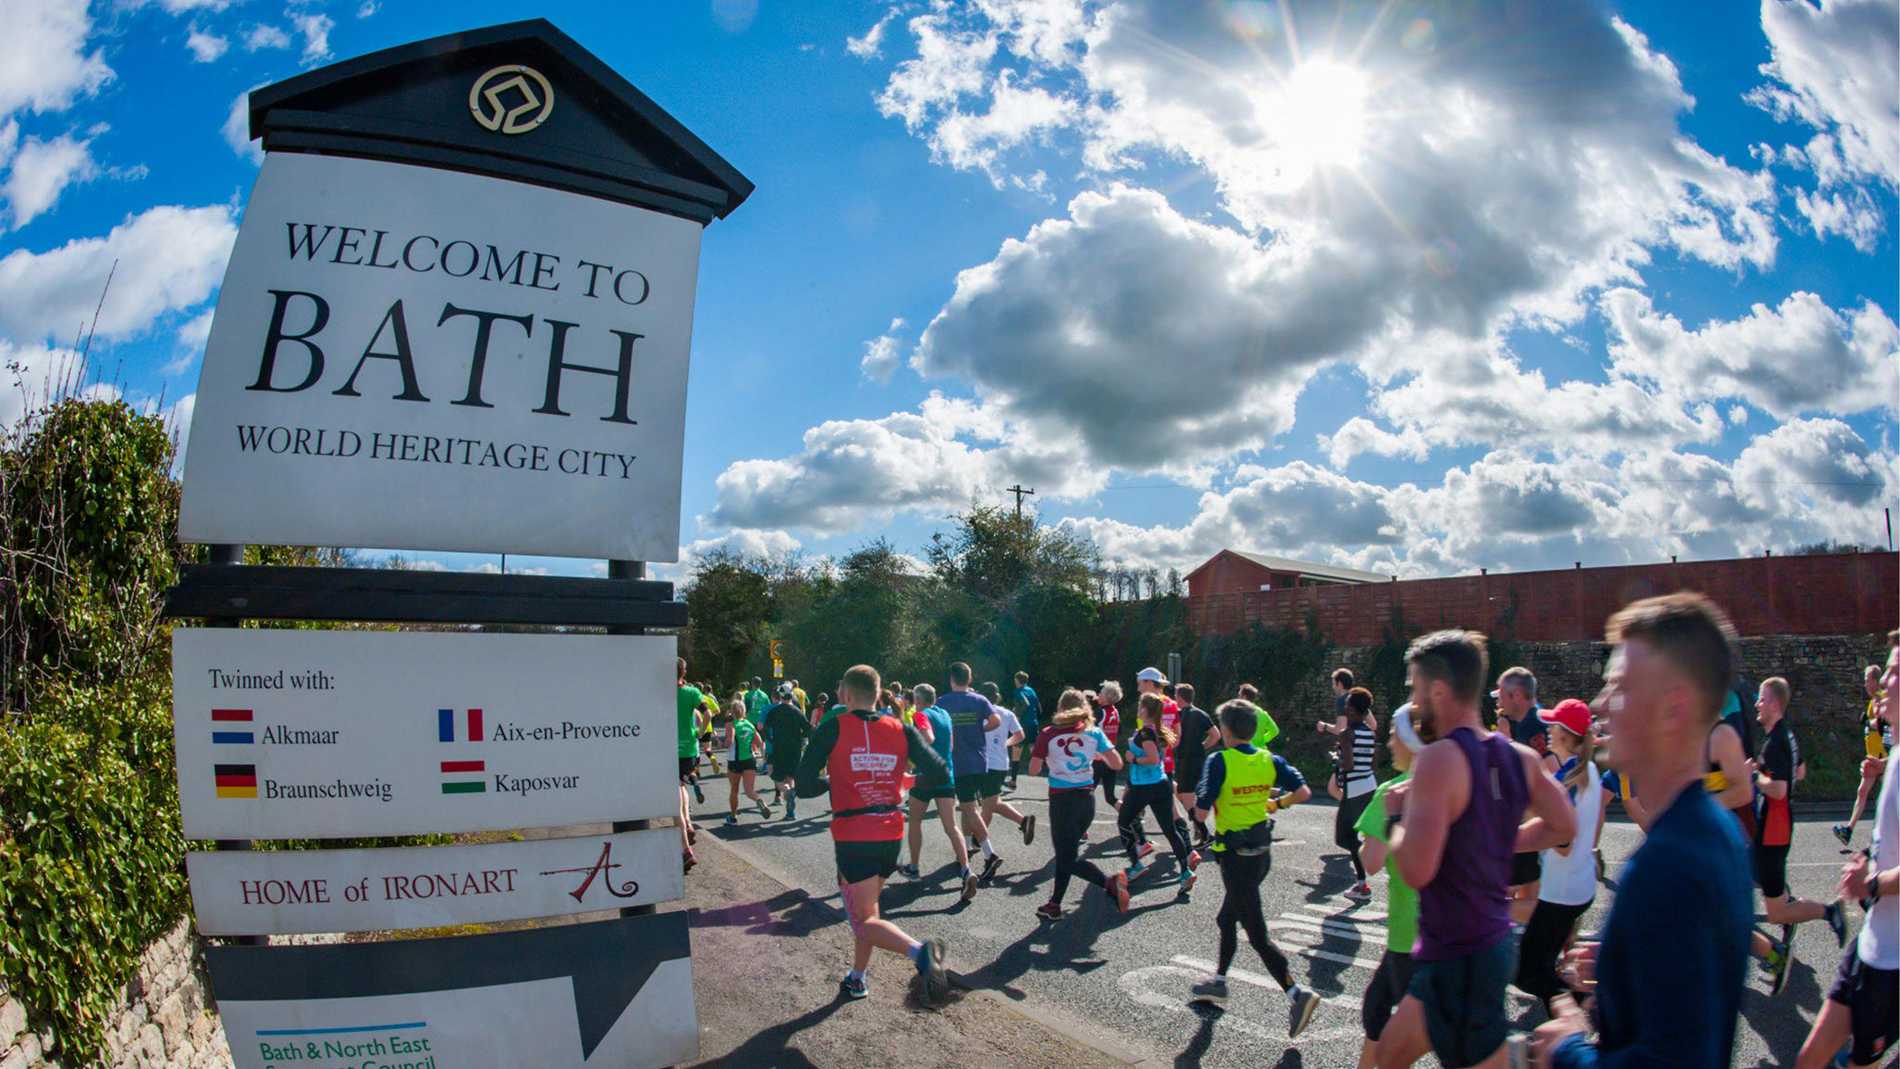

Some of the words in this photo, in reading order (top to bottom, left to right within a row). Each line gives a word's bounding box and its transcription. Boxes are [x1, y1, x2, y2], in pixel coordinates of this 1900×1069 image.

[285, 222, 560, 289] WELCOME
[577, 260, 650, 305] TO
[244, 289, 645, 425] BATH
[236, 425, 361, 456] WORLD
[370, 433, 549, 471] HERITAGE
[558, 449, 636, 479] CITY
[208, 669, 283, 689] Twinned
[290, 670, 334, 690] with:
[262, 725, 339, 744] Alkmaar
[493, 721, 640, 741] Aix-en-Provence
[264, 778, 392, 802] Braunschweig
[494, 774, 580, 796] Kaposvar
[240, 880, 330, 905] HOME
[344, 877, 368, 902] of
[381, 869, 518, 900] IRONART
[260, 1043, 303, 1060] Bath
[307, 1042, 322, 1059] &
[324, 1038, 386, 1058] North
[390, 1037, 431, 1054] East
